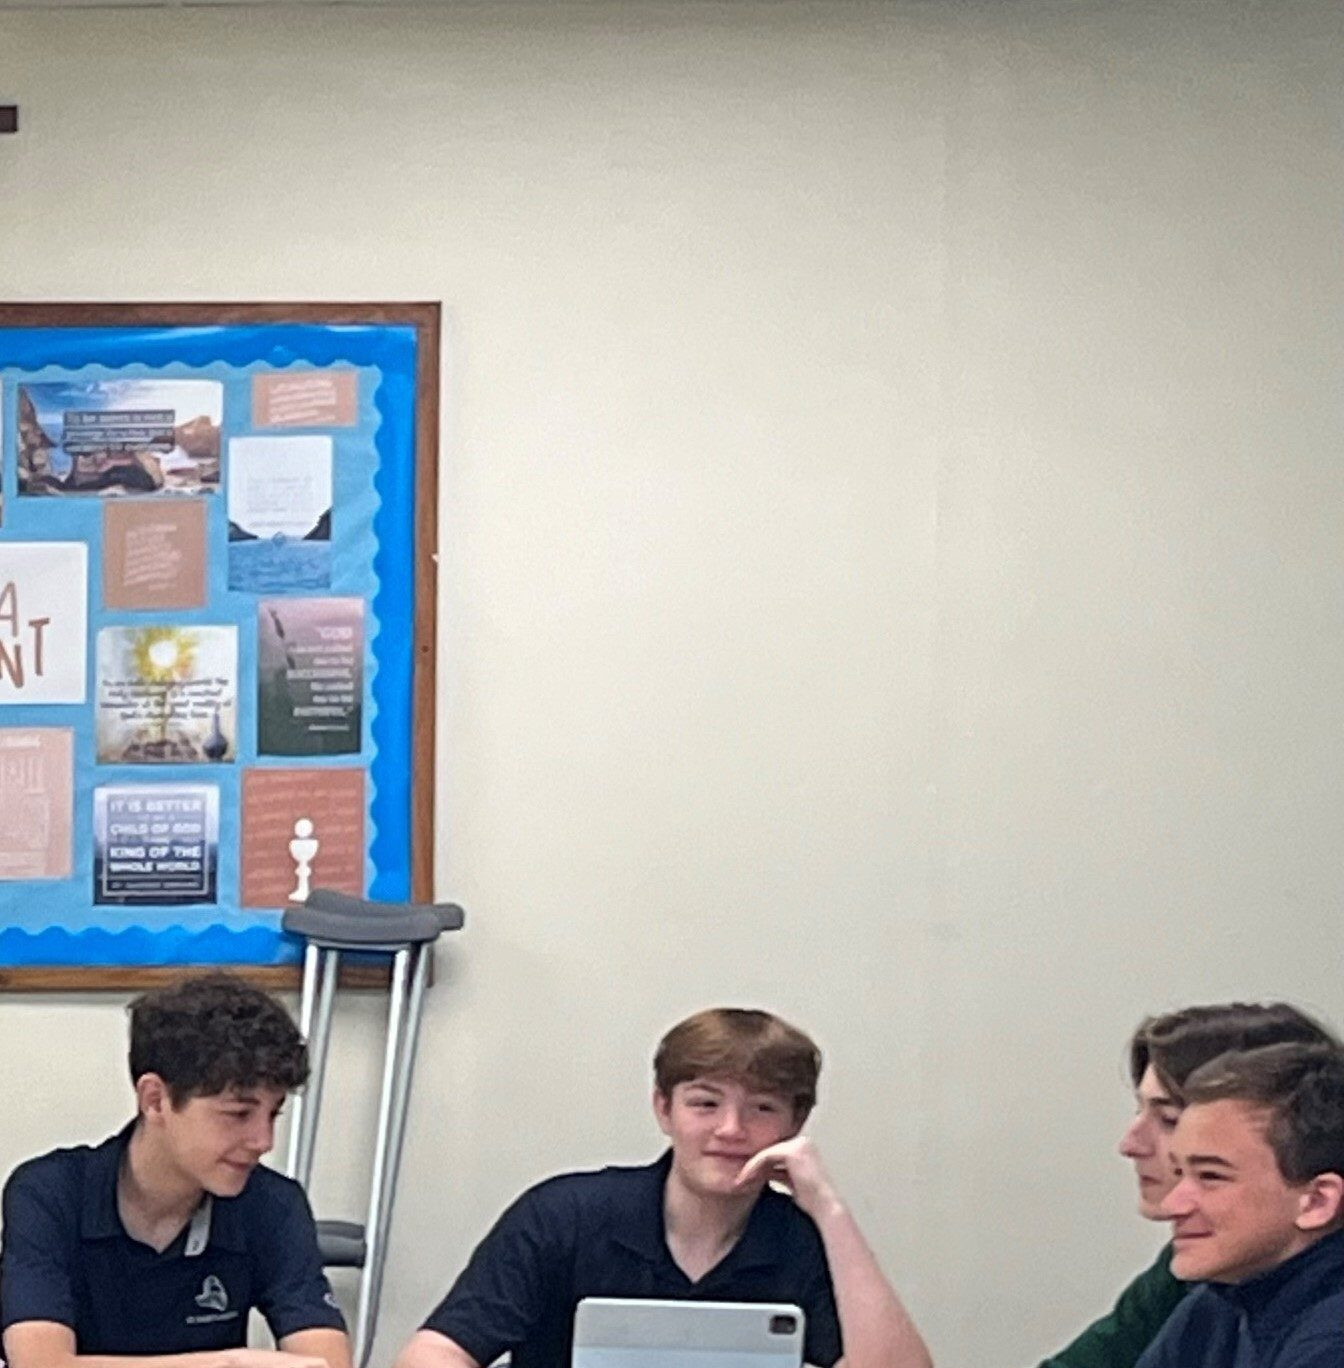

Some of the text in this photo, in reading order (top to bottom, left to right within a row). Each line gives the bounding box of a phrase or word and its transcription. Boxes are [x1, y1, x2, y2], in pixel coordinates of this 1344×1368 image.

[110, 845, 202, 858] KING OF THE
